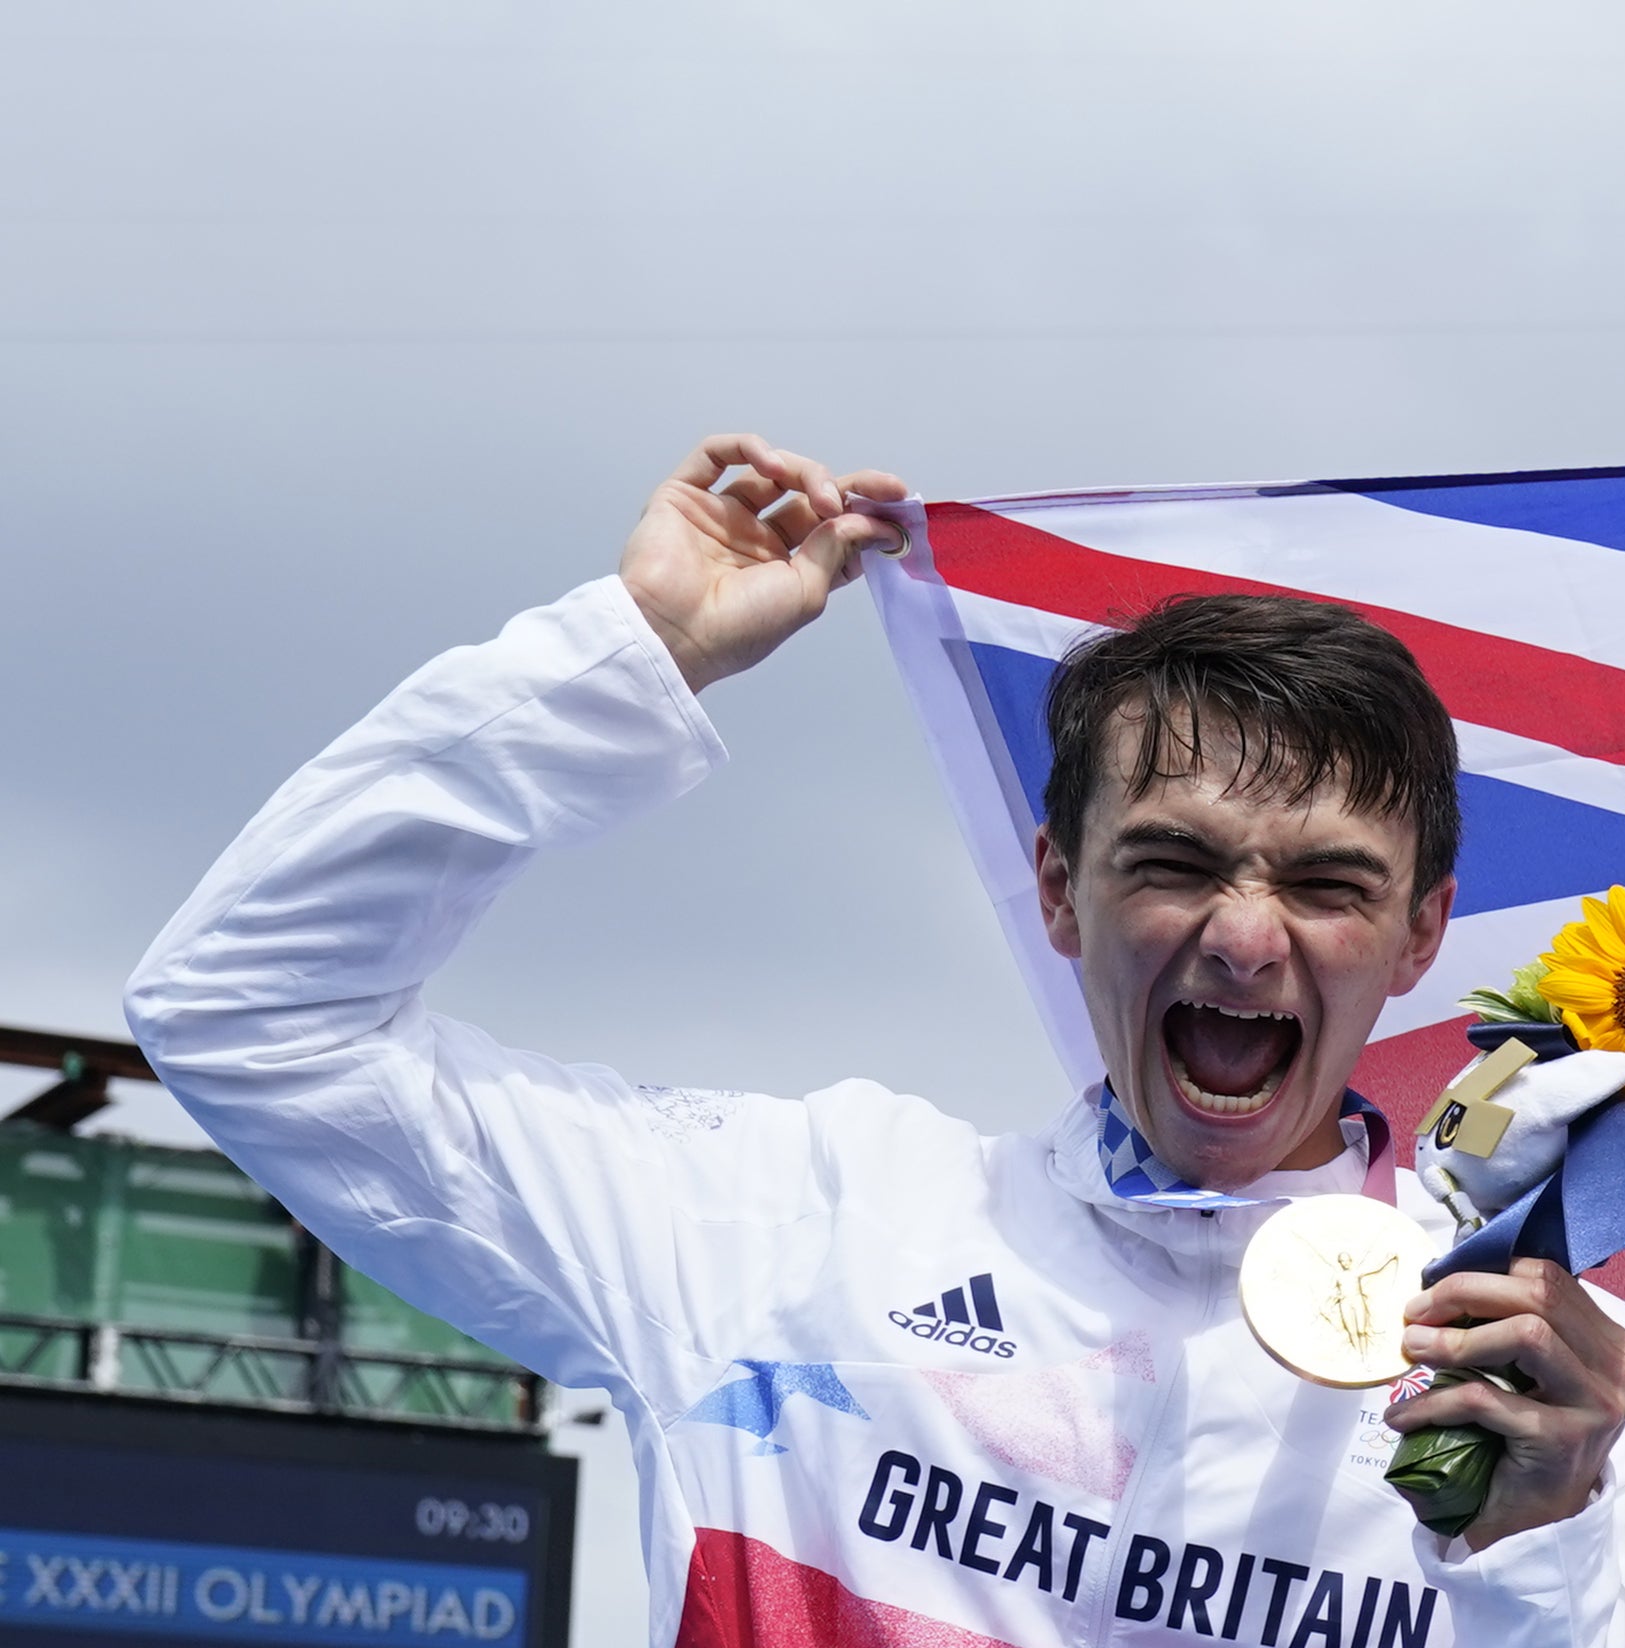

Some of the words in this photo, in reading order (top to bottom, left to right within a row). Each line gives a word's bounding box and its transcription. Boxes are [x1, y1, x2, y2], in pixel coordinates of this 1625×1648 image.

[888, 1308, 1017, 1361] adidas
[1350, 1455, 1388, 1468] TOKYO
[415, 1497, 530, 1543] 09:30
[858, 1449, 1111, 1604] GREAT
[24, 1553, 178, 1614] XXXII
[194, 1567, 516, 1640] OLYMPIAD
